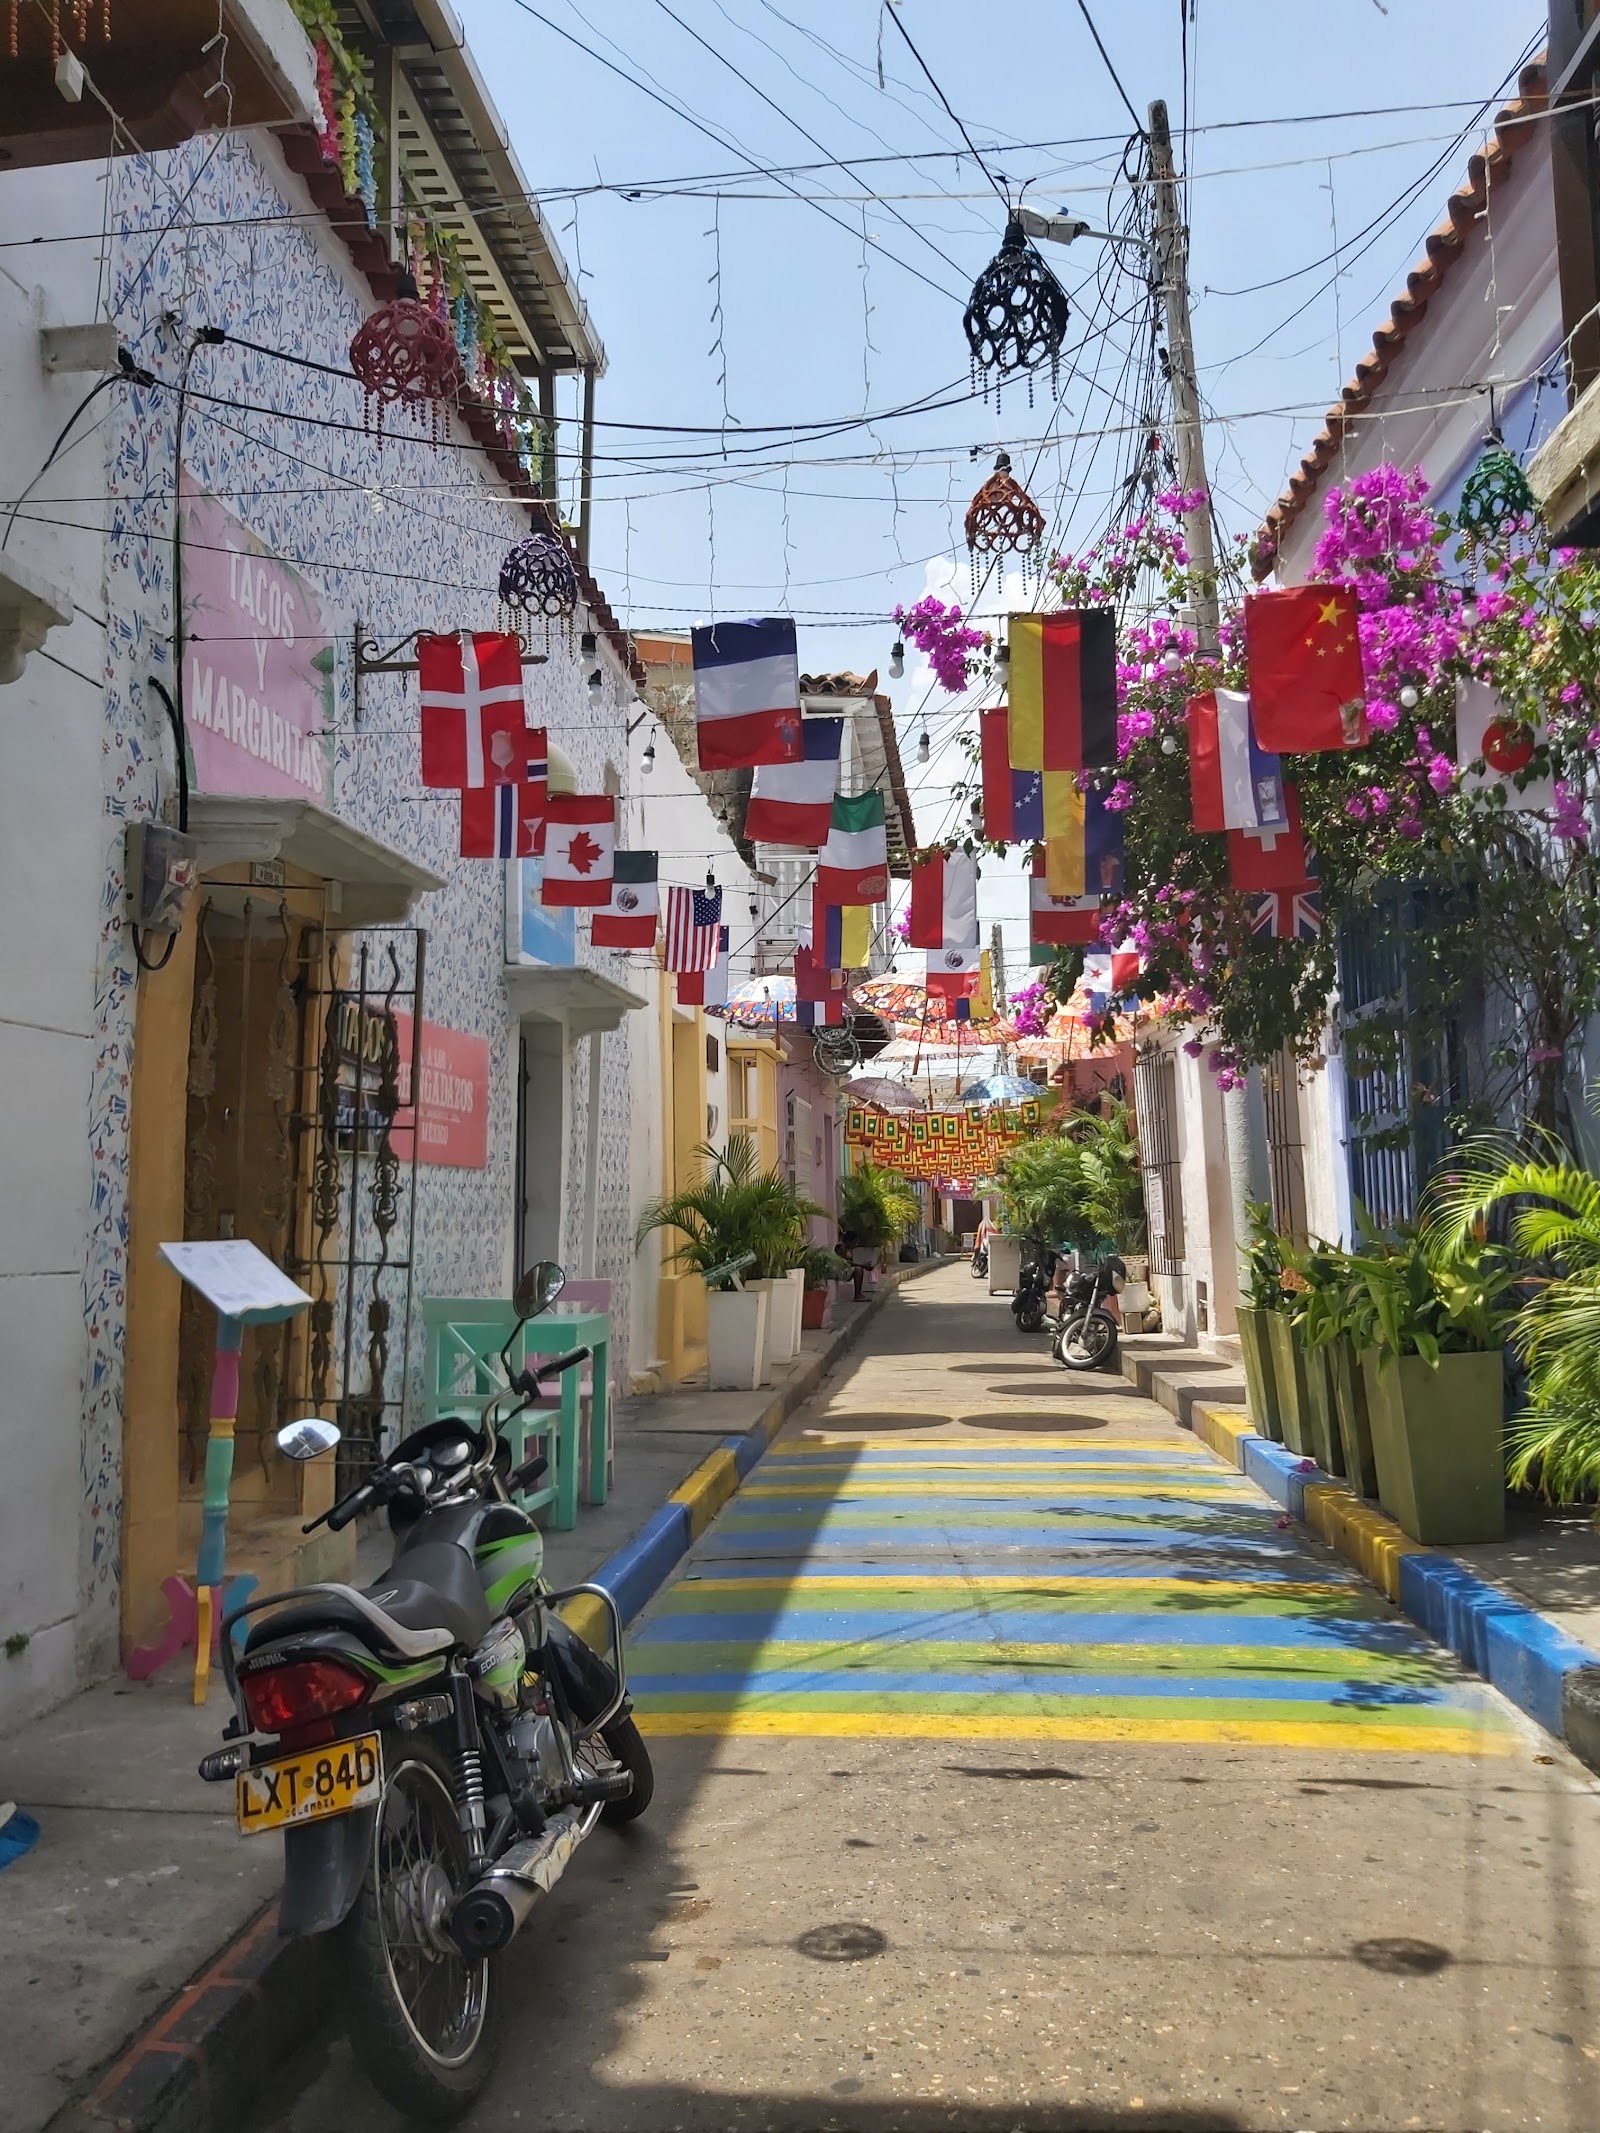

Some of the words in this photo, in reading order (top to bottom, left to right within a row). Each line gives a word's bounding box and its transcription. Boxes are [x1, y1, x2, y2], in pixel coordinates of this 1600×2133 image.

[226, 539, 295, 649] TACOS
[253, 631, 268, 692] Y
[191, 656, 322, 794] MARGARITAS
[480, 1654, 496, 1674] ECO
[242, 1766, 300, 1818] LXT
[315, 1747, 376, 1796] 84D
[285, 1798, 335, 1818] COLOMBIA
